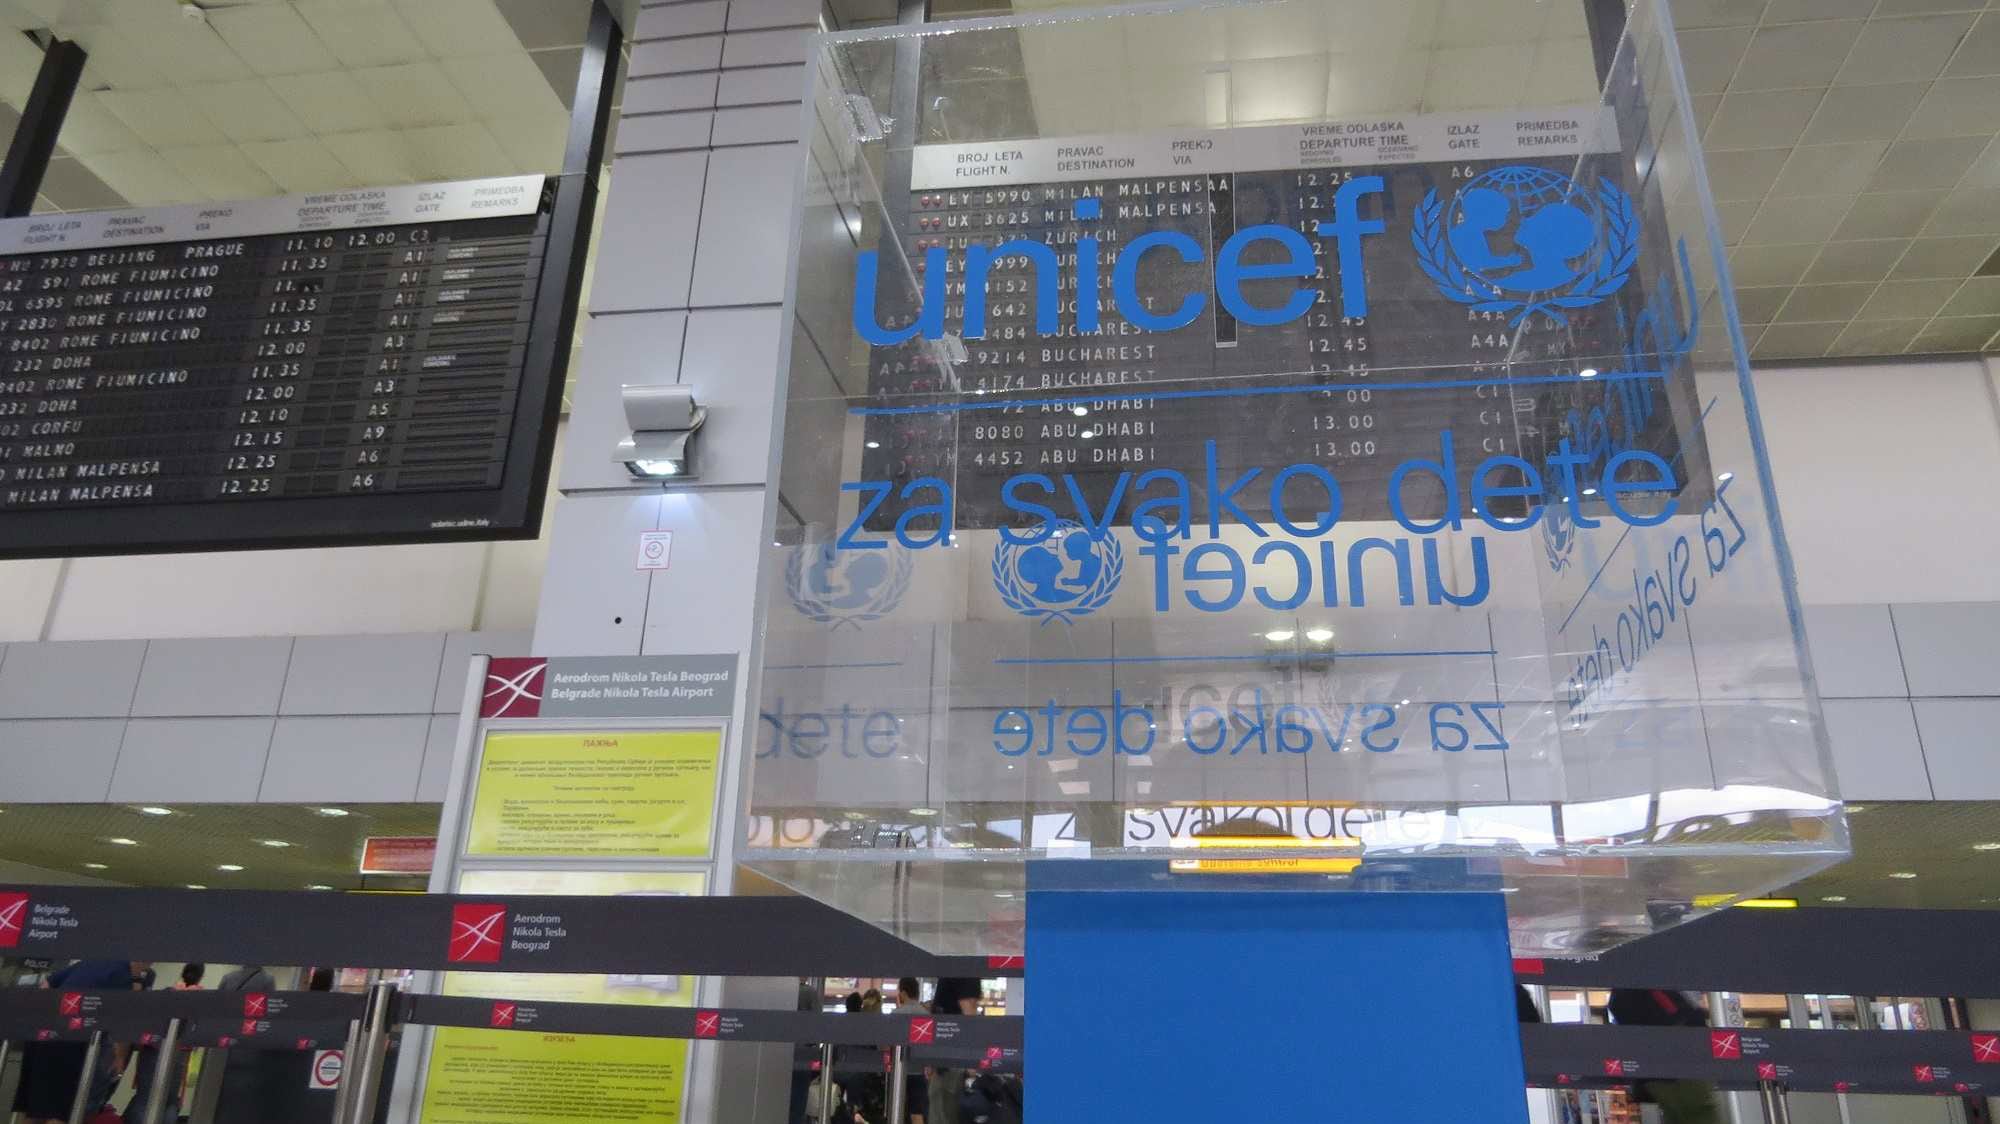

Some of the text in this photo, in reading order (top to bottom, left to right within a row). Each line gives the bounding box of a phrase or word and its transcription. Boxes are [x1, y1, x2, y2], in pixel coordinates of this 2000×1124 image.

[1302, 121, 1404, 136] VREME ODLASKA
[1447, 125, 1480, 136] IZLAZ
[1516, 120, 1579, 132] PRIMEDBA
[1300, 137, 1375, 150] DEPARTURE
[1379, 135, 1408, 145] TIME
[1448, 138, 1481, 149] GATE
[1517, 134, 1578, 146] REMARKS
[957, 151, 1023, 163] BROJ LETA
[1057, 146, 1104, 158] PRAVAC
[1057, 158, 1135, 171] DESTINATION
[1172, 155, 1193, 165] VIA
[956, 166, 997, 177] FLIGHT
[985, 190, 1031, 204] 5990
[1045, 185, 1104, 201] MILAN
[1452, 167, 1474, 178] A6
[296, 201, 387, 217] DEPARTURE TIME
[470, 197, 519, 208] REMARKS
[947, 215, 969, 227] UX
[1119, 201, 1218, 218] MALPENSA
[87, 250, 156, 266] BEIJING
[184, 243, 245, 258] PRAGUE
[851, 175, 1385, 346] unicef
[80, 272, 120, 287] ROME
[129, 265, 219, 282] FIUMICINO
[74, 293, 113, 307] ROME
[123, 286, 213, 303] FIUMICINO
[945, 283, 966, 295] YM
[66, 313, 105, 328] ROME
[116, 306, 207, 323] FIUMICINO
[992, 304, 1028, 317] 642
[10, 338, 49, 351] 8402
[59, 335, 99, 348] ROME
[109, 327, 201, 345] FIUMICINO
[52, 356, 92, 370] DOHA
[384, 335, 404, 348] A3
[978, 351, 1025, 364] 9214
[1042, 346, 1155, 362] BUCHAREST
[1471, 333, 1509, 348] A4A
[45, 376, 86, 391] ROME
[96, 369, 189, 388] FIUMICINO
[37, 400, 78, 414] DOHA
[374, 380, 394, 393] A3
[32, 420, 83, 435] CORFU
[369, 402, 389, 416] A5
[976, 426, 1024, 439] 8080
[1041, 424, 1077, 438] ABU
[1094, 421, 1154, 436] DHABI
[22, 443, 75, 458] MALMO
[363, 426, 385, 439] A9
[974, 451, 1023, 465] 4452
[1040, 448, 1077, 464] ABU
[1093, 447, 1154, 462] DHABI
[16, 464, 67, 480] MILAN
[76, 461, 161, 478] MALPENSA
[358, 450, 379, 463] A6
[7, 489, 60, 503] MILAN
[69, 484, 153, 501] MALPENSA
[352, 474, 374, 487] A6
[836, 430, 1679, 551] za svako dete
[553, 671, 728, 685] Aerodrom Nikola Tesla Beograd
[551, 686, 714, 702] Belgrade Nikola Tesla Airport
[34, 904, 71, 915] Belgrade
[32, 917, 79, 927] Nikola Tesla
[514, 913, 561, 924] Aerodrom
[28, 929, 58, 940] Airport
[513, 927, 567, 938] Nikola Tesla
[511, 941, 550, 952] Beograd
